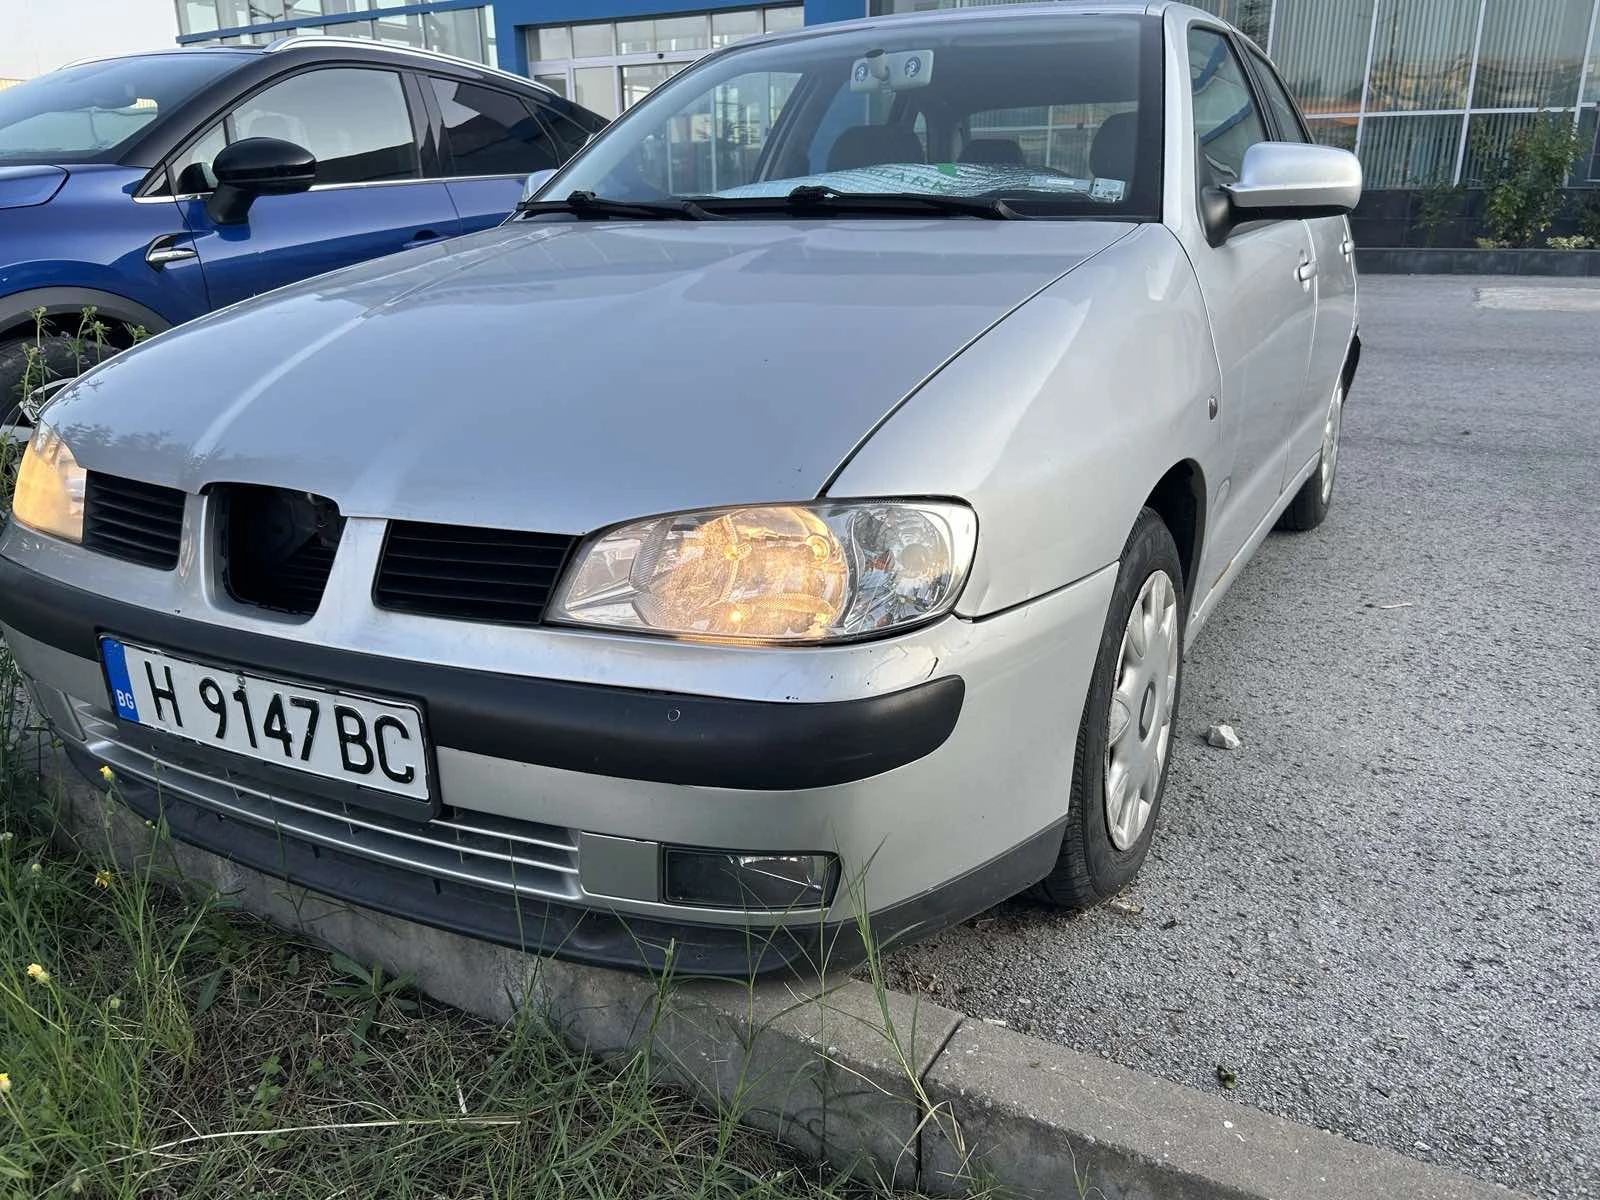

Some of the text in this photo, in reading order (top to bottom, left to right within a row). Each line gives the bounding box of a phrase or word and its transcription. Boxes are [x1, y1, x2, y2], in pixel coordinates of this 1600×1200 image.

[116, 688, 135, 710] BG
[144, 660, 416, 785] H 9147 BC
